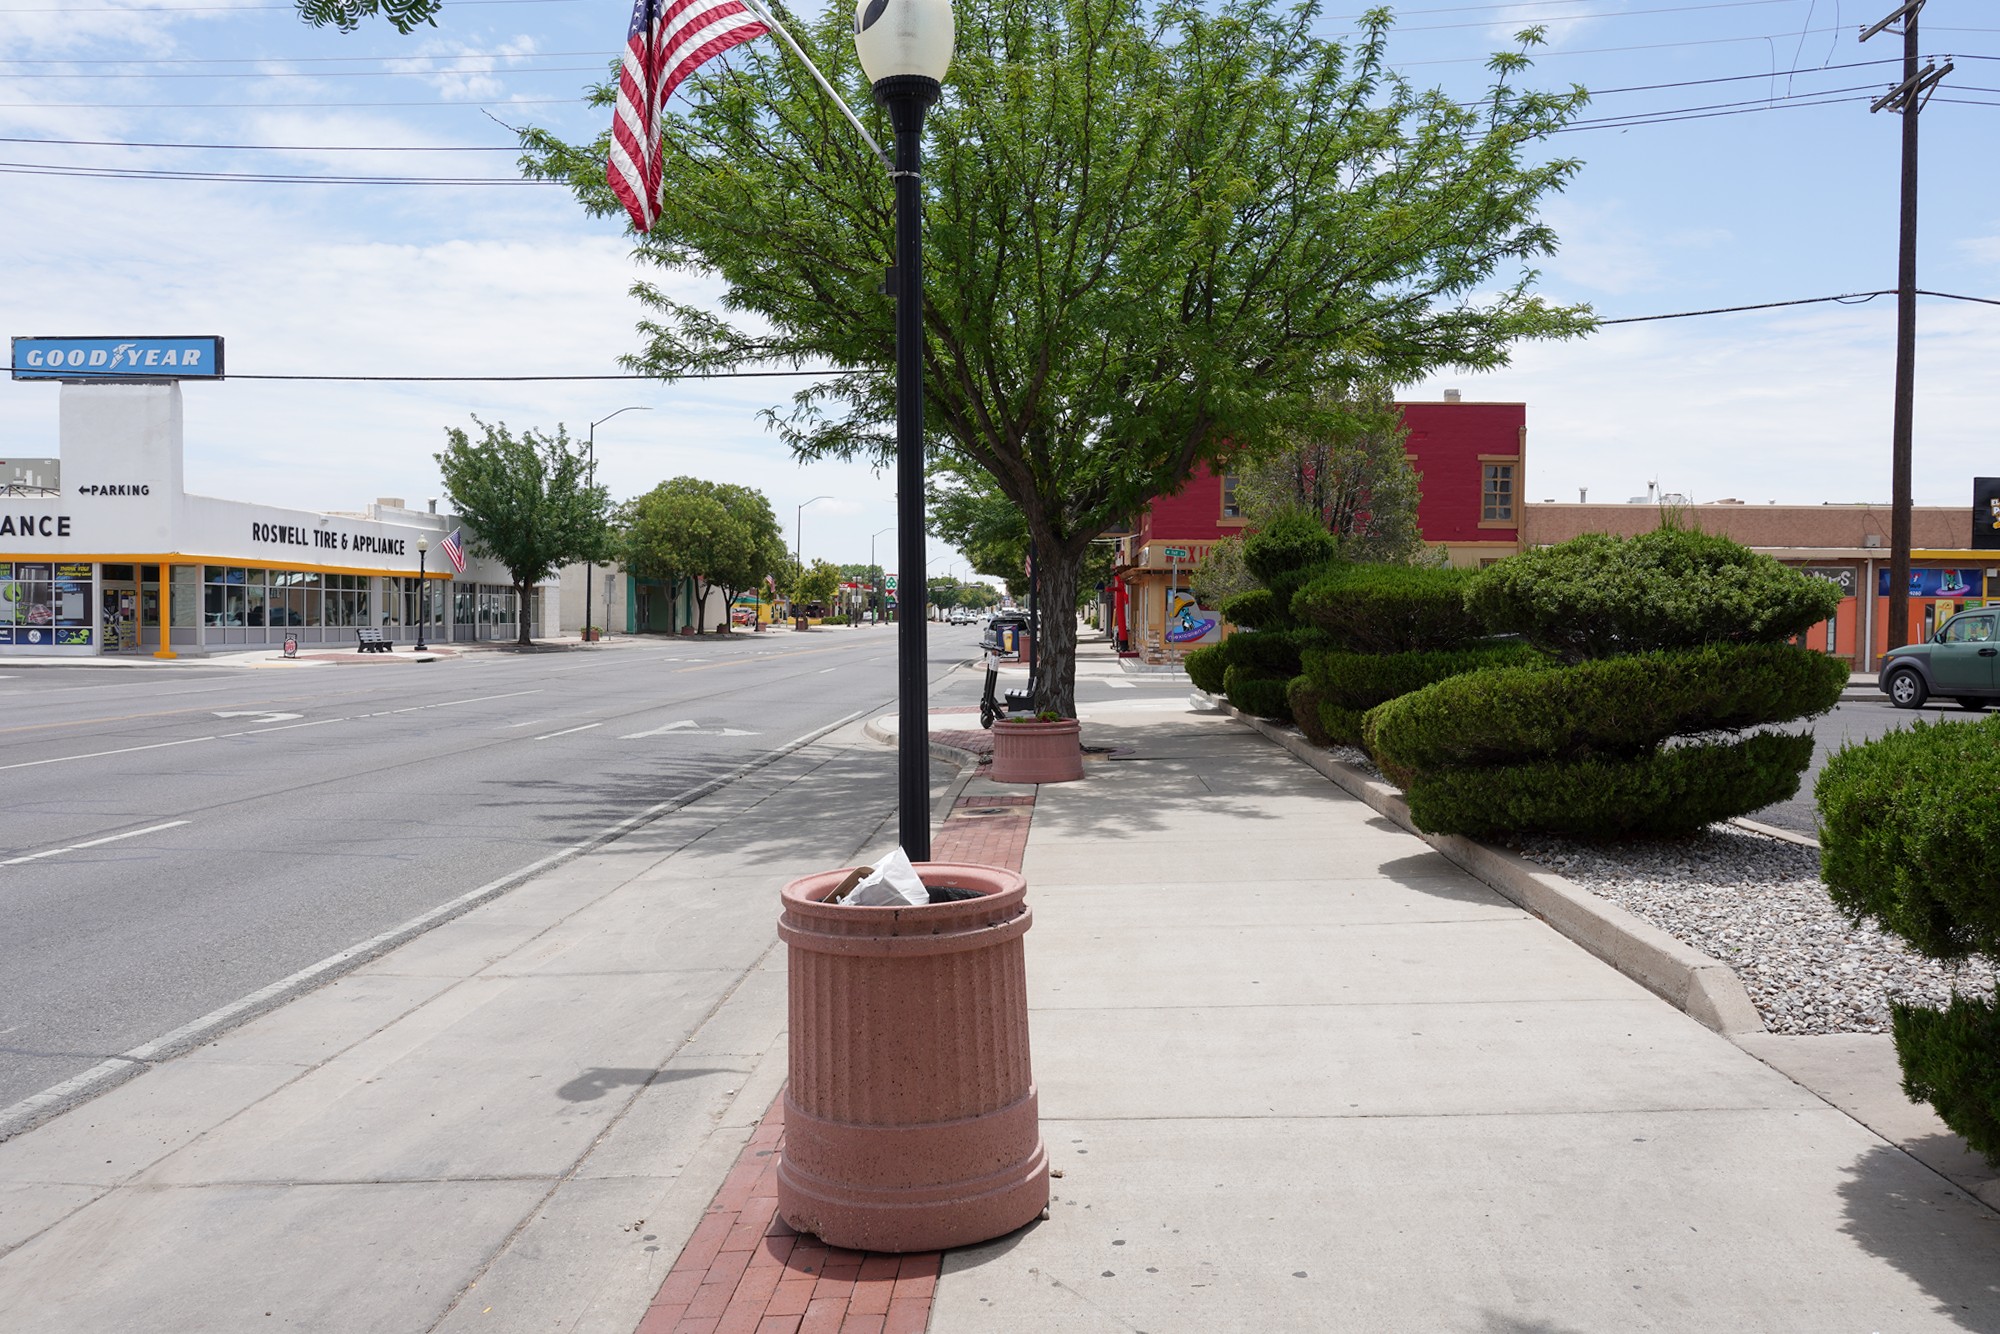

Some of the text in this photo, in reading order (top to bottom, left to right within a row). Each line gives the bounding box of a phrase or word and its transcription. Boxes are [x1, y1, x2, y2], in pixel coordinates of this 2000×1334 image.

[91, 485, 150, 496] PARKING
[0, 515, 71, 537] ANCE
[252, 522, 405, 556] ROSWELL TIRE & APPLIANCE
